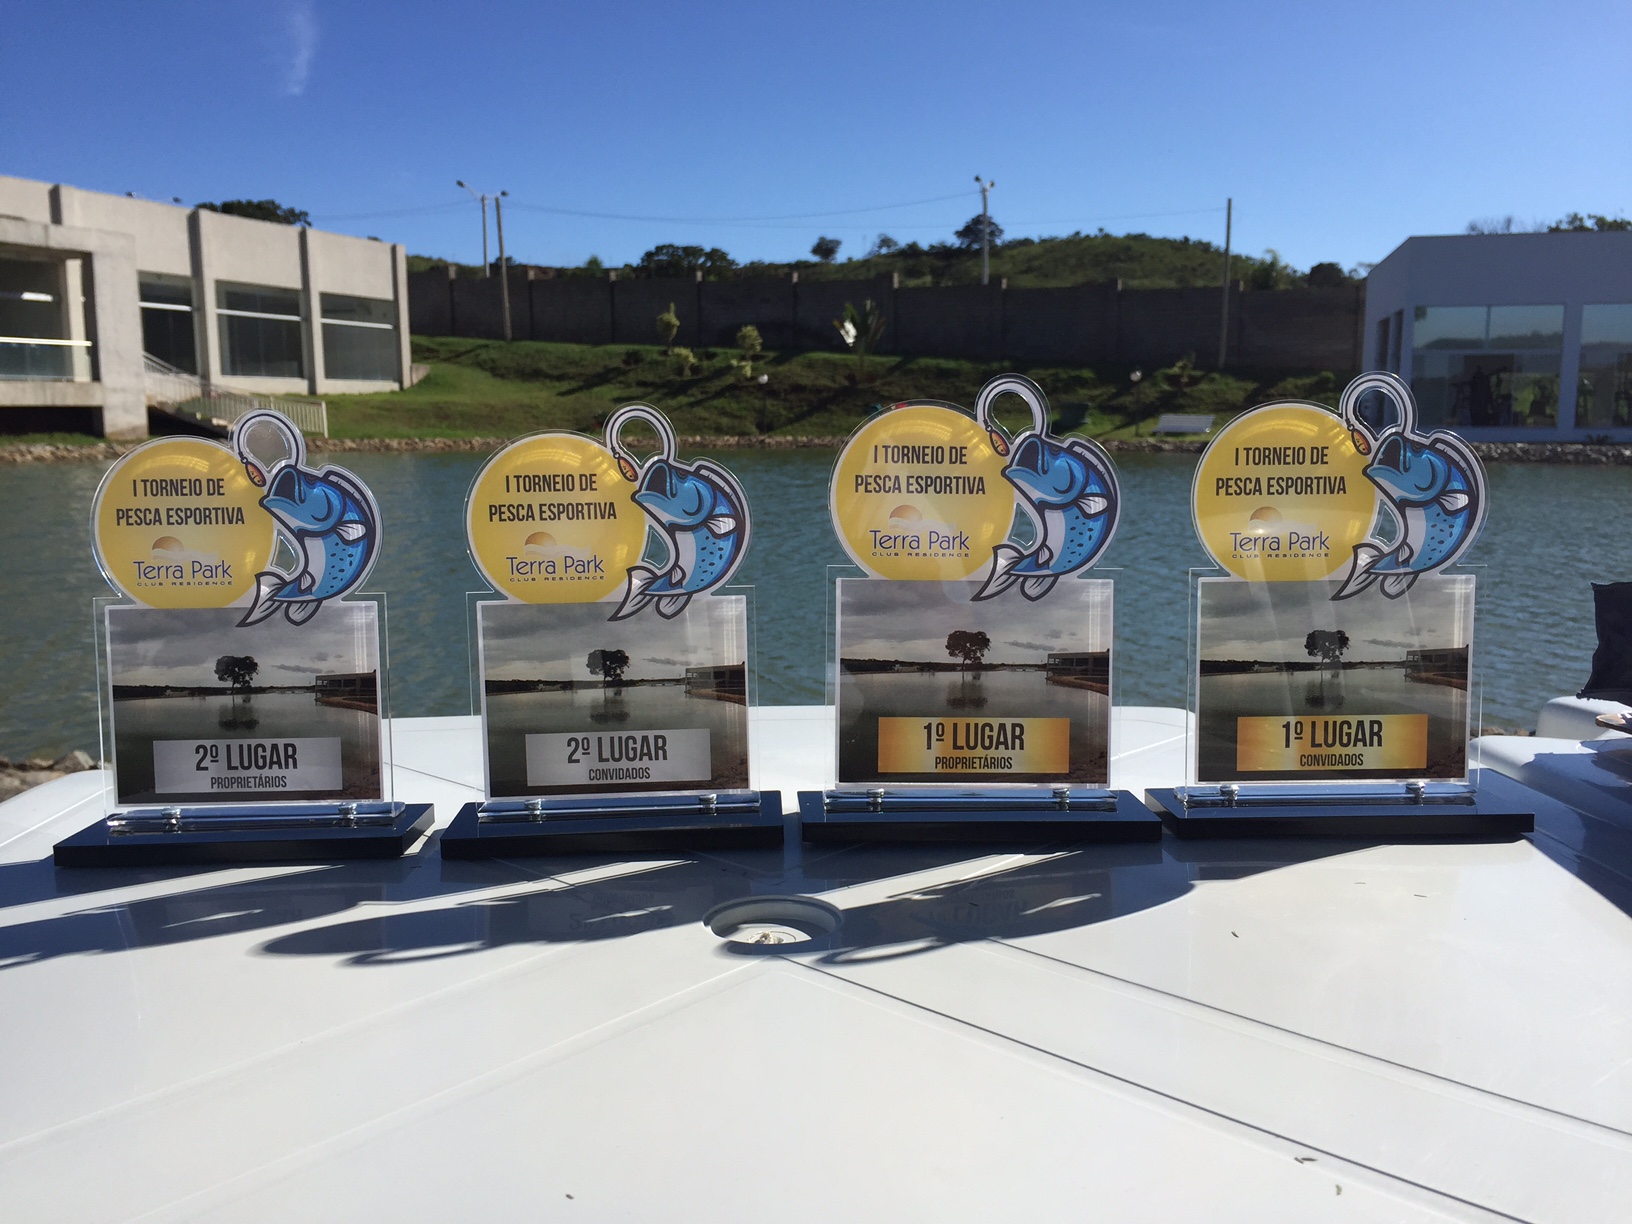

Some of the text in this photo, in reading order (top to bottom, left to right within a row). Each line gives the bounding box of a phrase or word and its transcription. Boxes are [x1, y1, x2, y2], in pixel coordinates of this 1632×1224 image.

[874, 445, 967, 465] I TORNEIO DE
[1235, 447, 1328, 466] I TORNEIO DE
[133, 478, 225, 497] I TORNEIO DE
[506, 474, 597, 493] I TORNEIO DE
[855, 475, 985, 495] PESCA ESPORTIVA
[1216, 476, 1346, 496] PESCA ESPORTIVA
[116, 507, 244, 526] PESCA ESPORTIVA
[489, 502, 617, 522] PESCA ESPORTIVA
[870, 530, 969, 550] Terra Park
[1230, 531, 1329, 551] Terra Park
[133, 560, 232, 579] Terra Park
[506, 555, 604, 576] Terra Park
[952, 722, 1025, 751] LUGAR
[1311, 720, 1382, 748] LUGAR
[227, 743, 297, 770] LUGAR
[597, 735, 667, 763] LUGAR
[935, 754, 1012, 769] PROPRIETÁRIOS
[1300, 753, 1364, 766] CONVIDADOS
[211, 774, 287, 789] PROPRIETÁRIOS
[589, 767, 651, 781] CONVIDADOS
